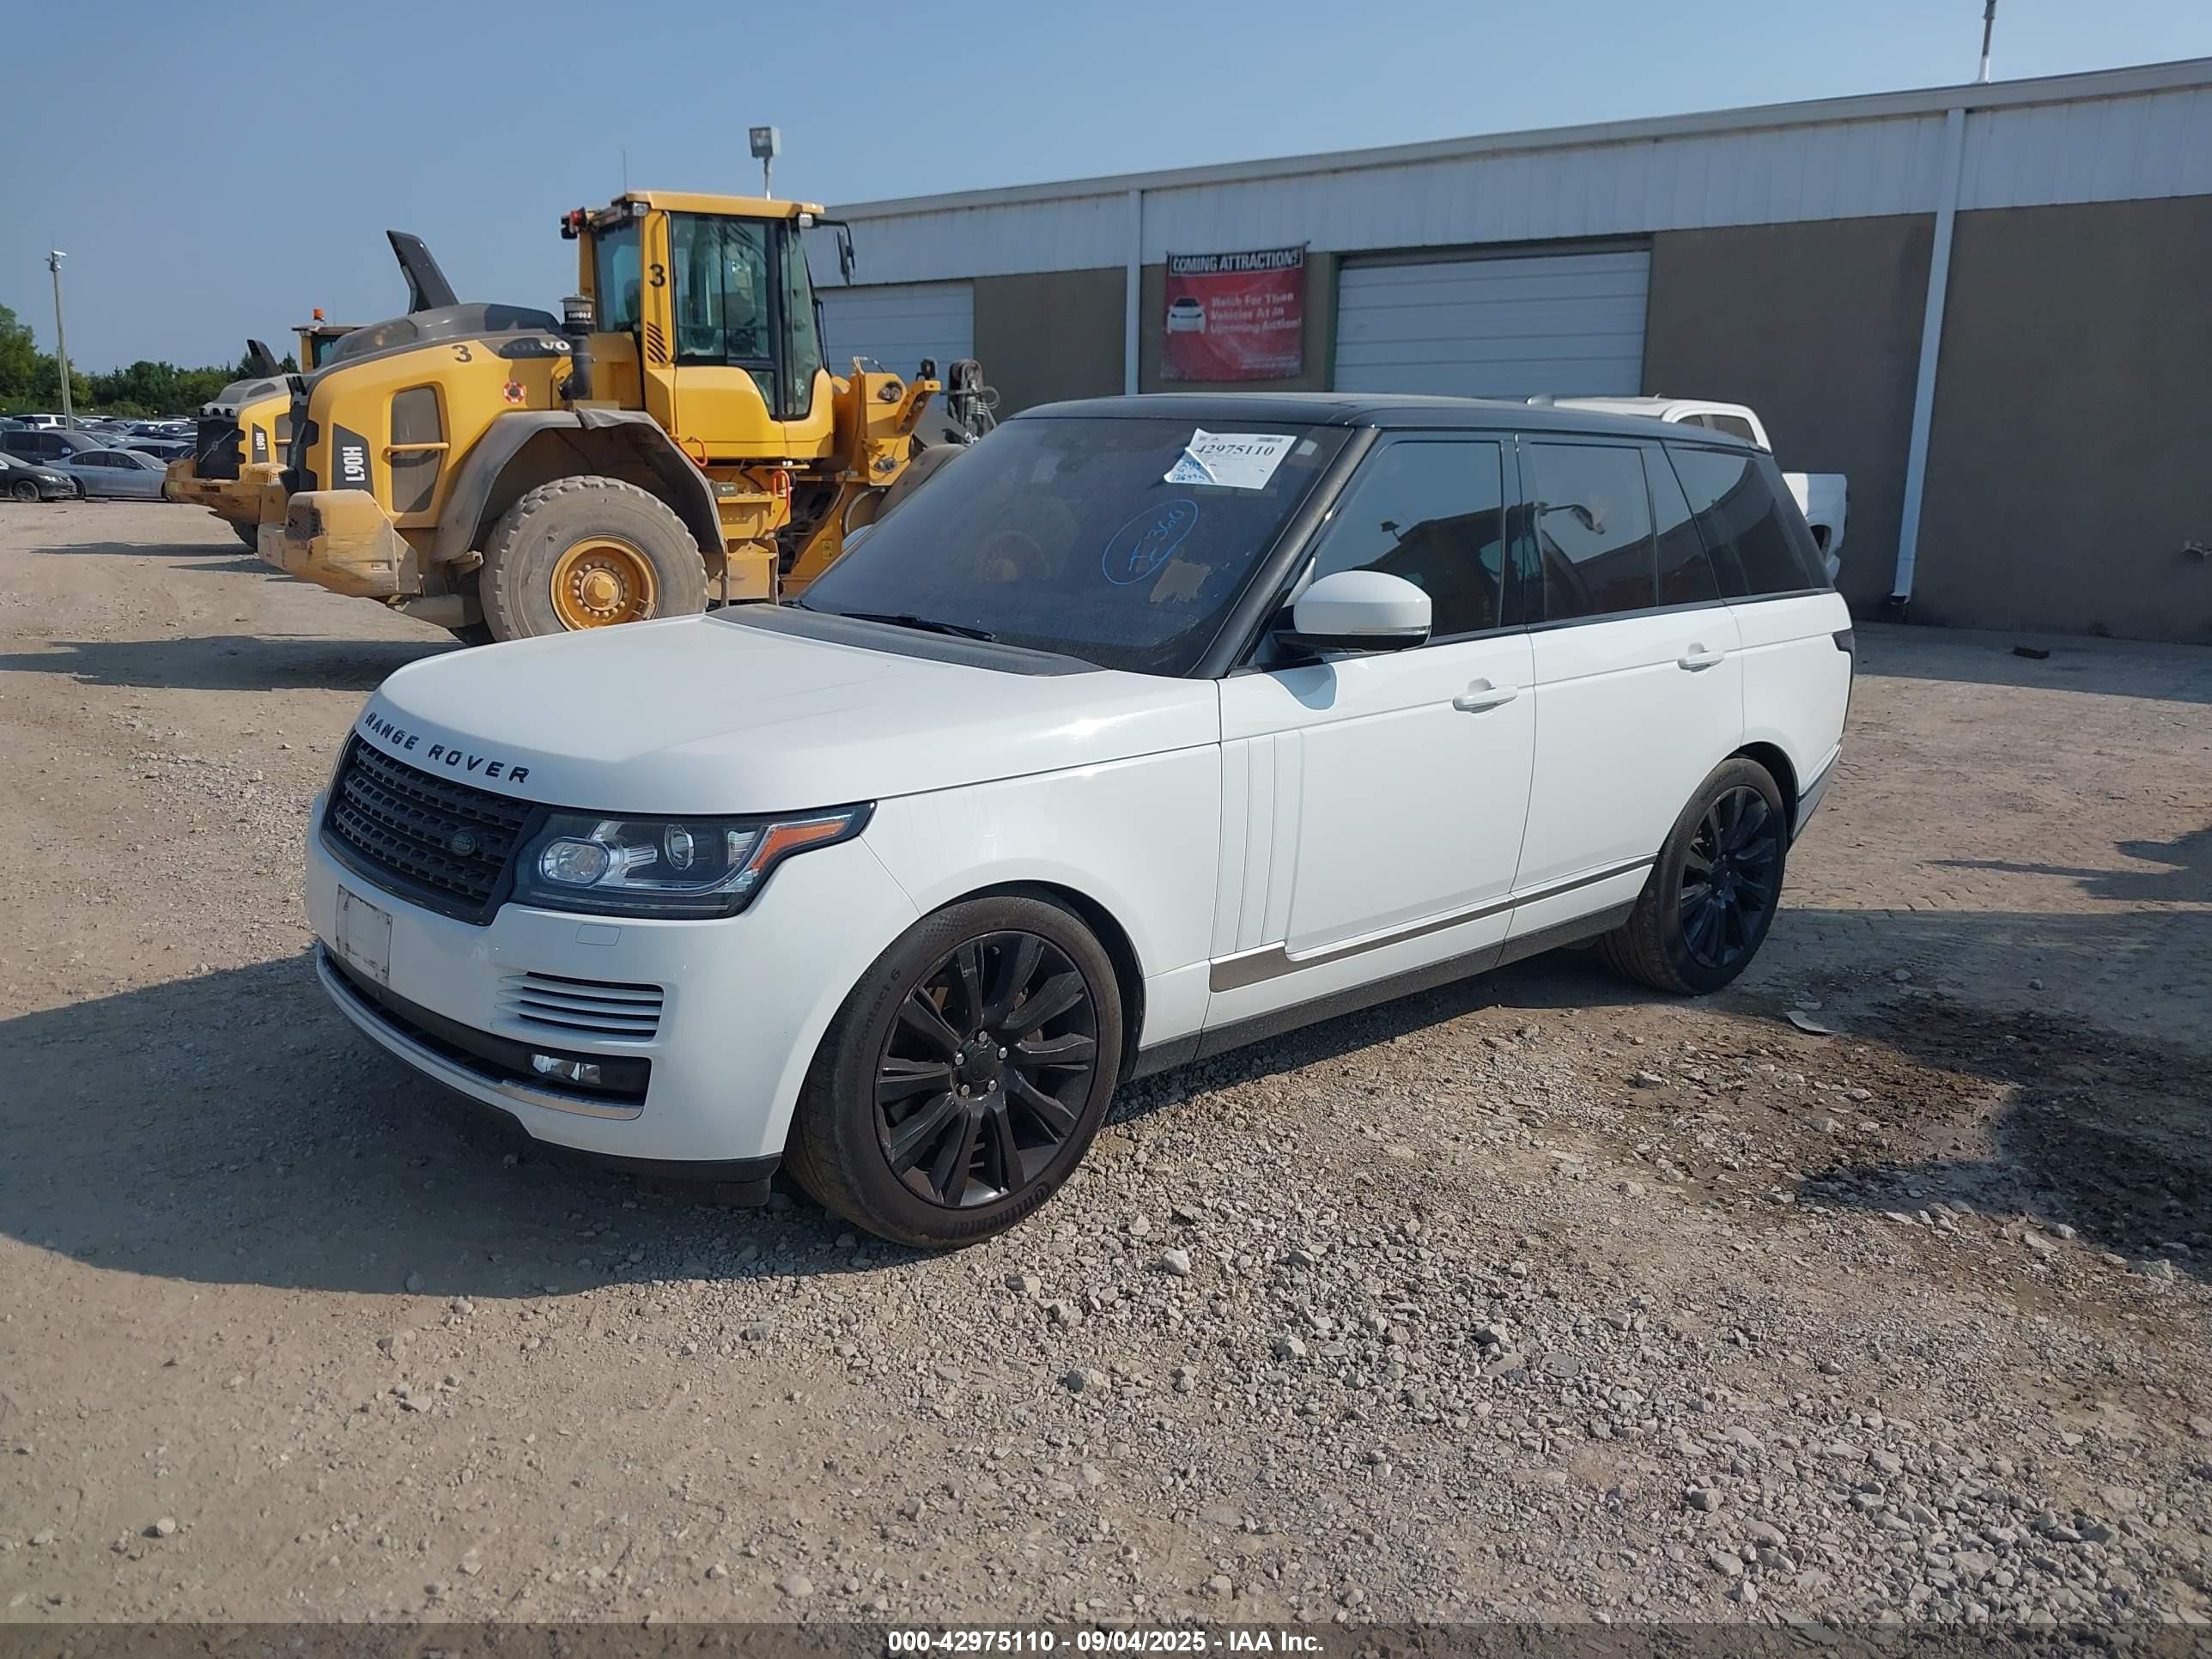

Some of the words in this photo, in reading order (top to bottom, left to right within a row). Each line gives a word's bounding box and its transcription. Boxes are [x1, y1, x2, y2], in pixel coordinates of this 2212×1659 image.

[1172, 255, 1218, 273] COMING
[649, 263, 665, 288] 3
[1245, 295, 1262, 306] For
[1256, 307, 1270, 319] At
[451, 344, 472, 362] 3
[1195, 444, 1275, 457] 42975110
[342, 446, 366, 482] L90H
[365, 712, 420, 751] RANGE
[428, 744, 530, 784] ROVER
